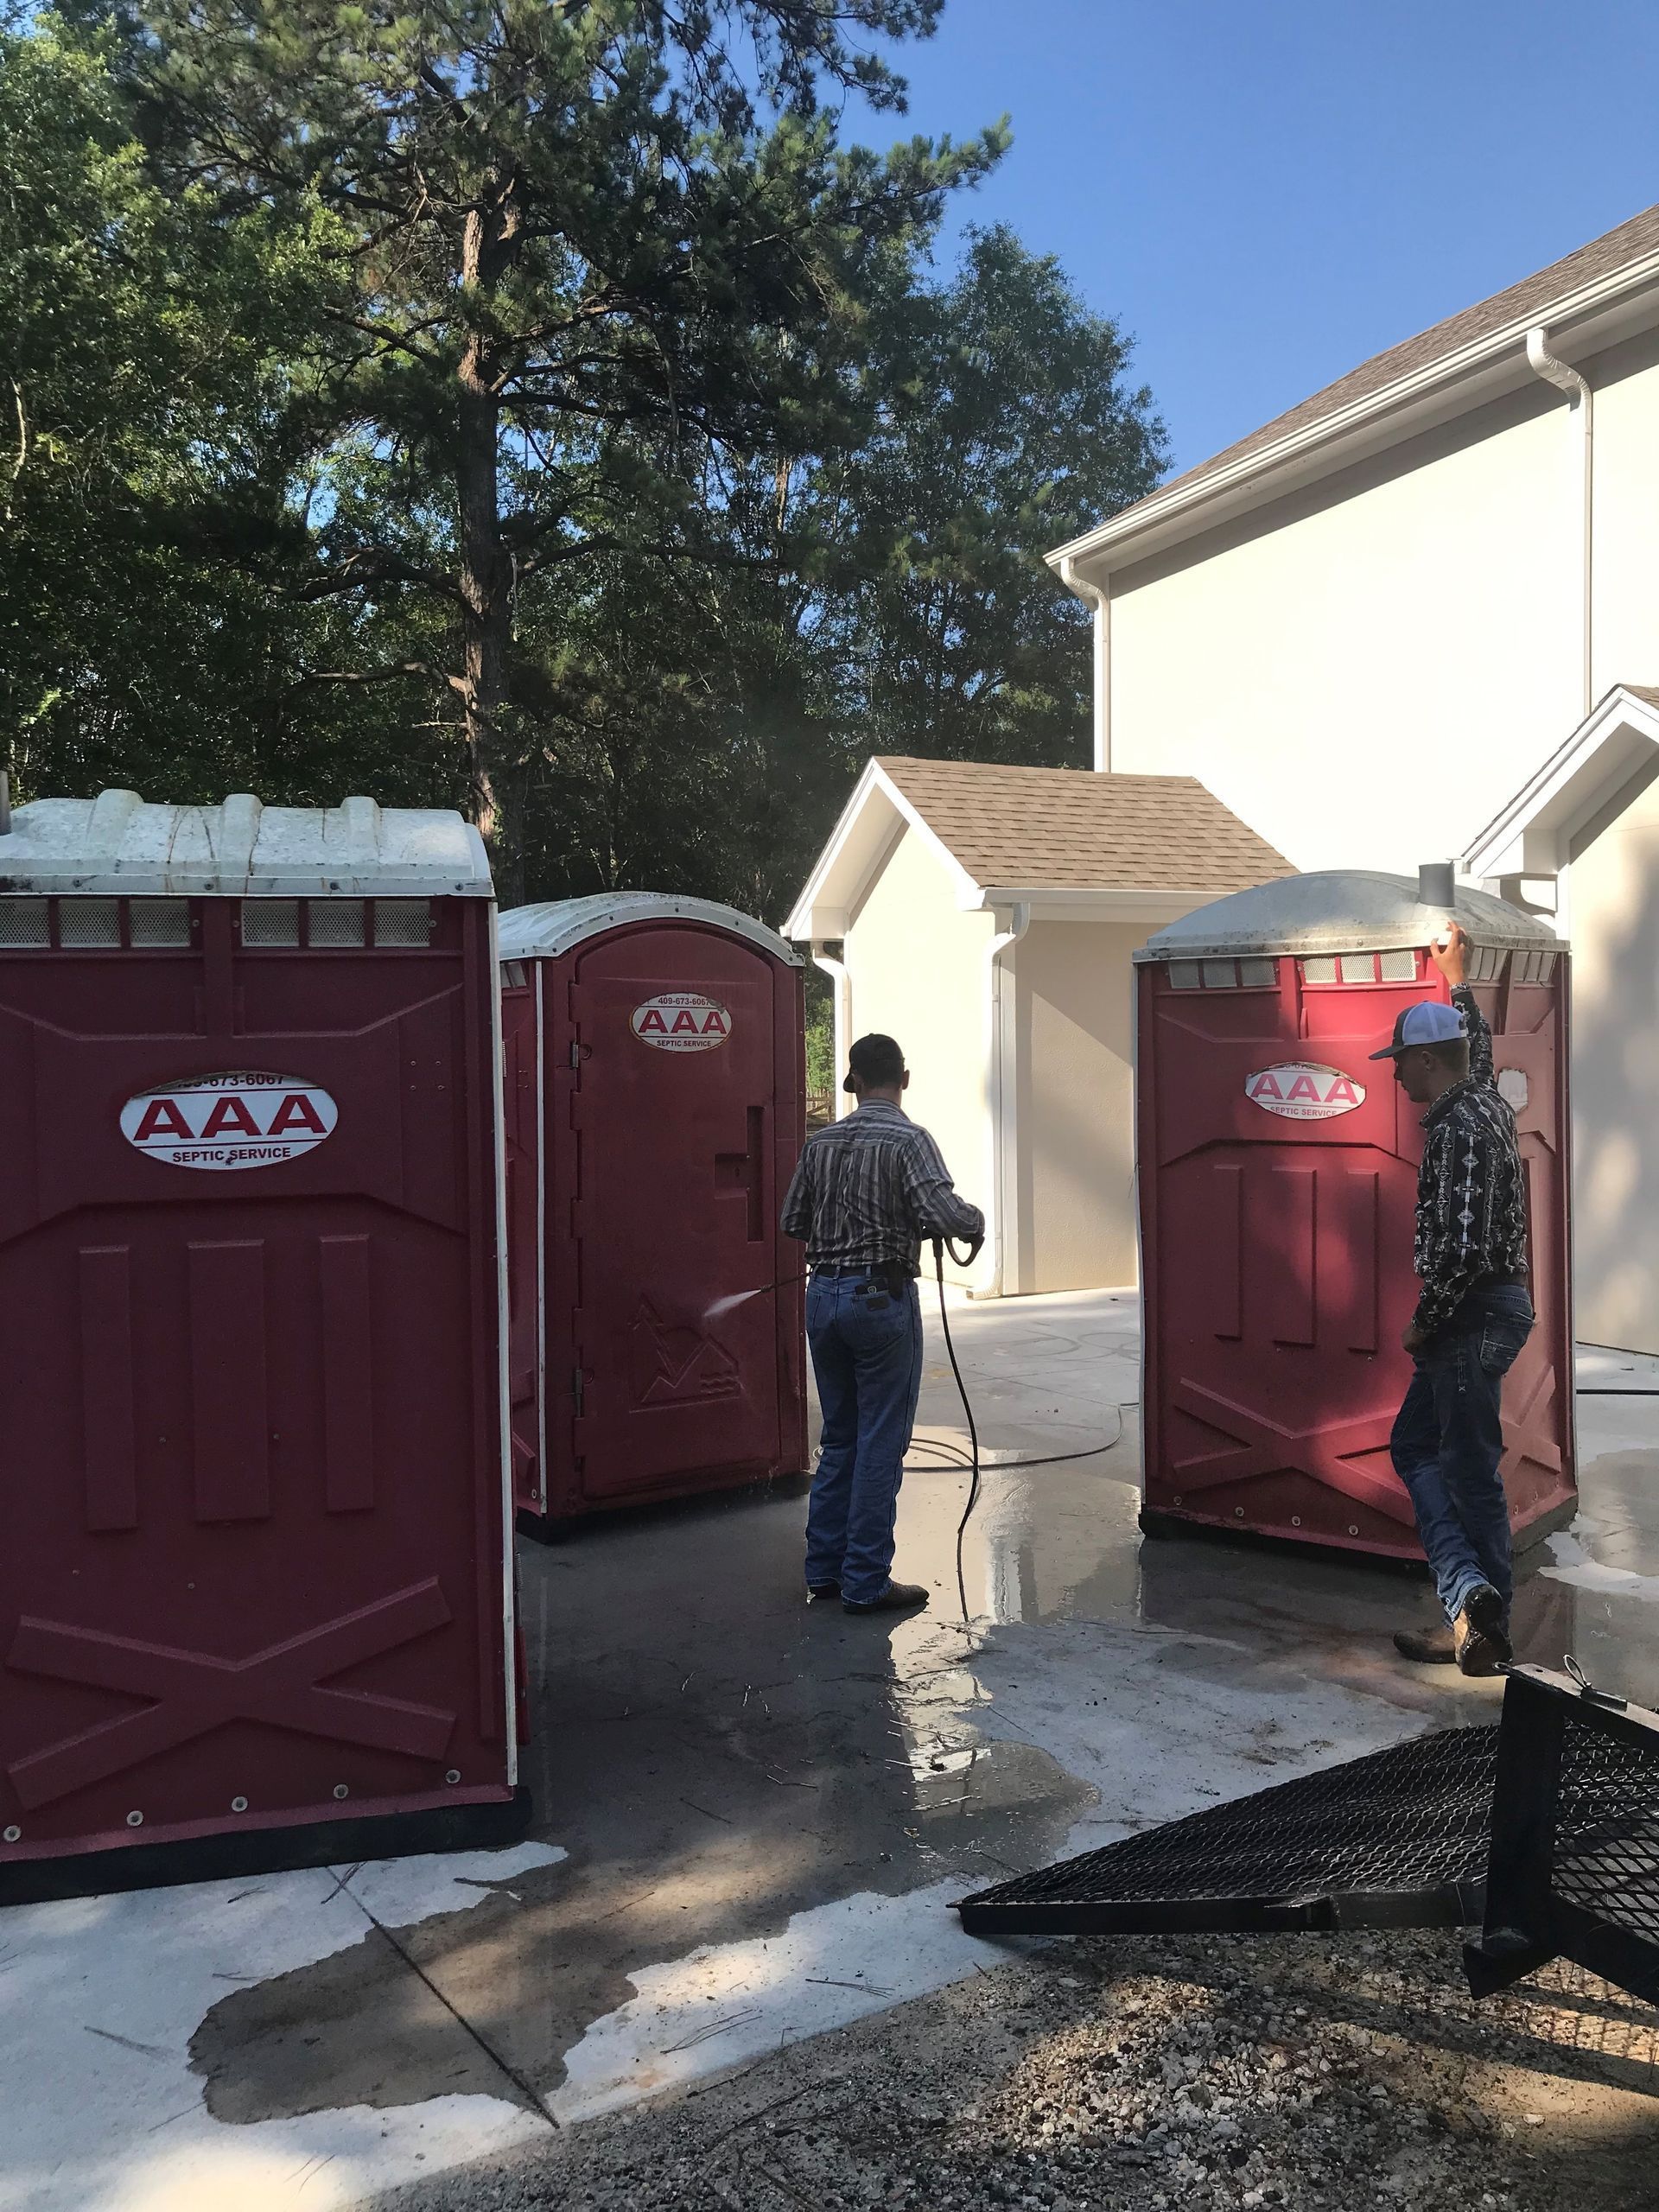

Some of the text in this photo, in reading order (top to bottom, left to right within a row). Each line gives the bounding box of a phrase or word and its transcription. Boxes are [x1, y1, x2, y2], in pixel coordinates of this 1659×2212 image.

[638, 1009, 727, 1034] AAA
[1250, 1073, 1359, 1104] AAA
[132, 1094, 328, 1141] AAA
[1270, 1106, 1300, 1116] SEPTIC
[172, 1147, 291, 1163] SEPTIC SERVICE
